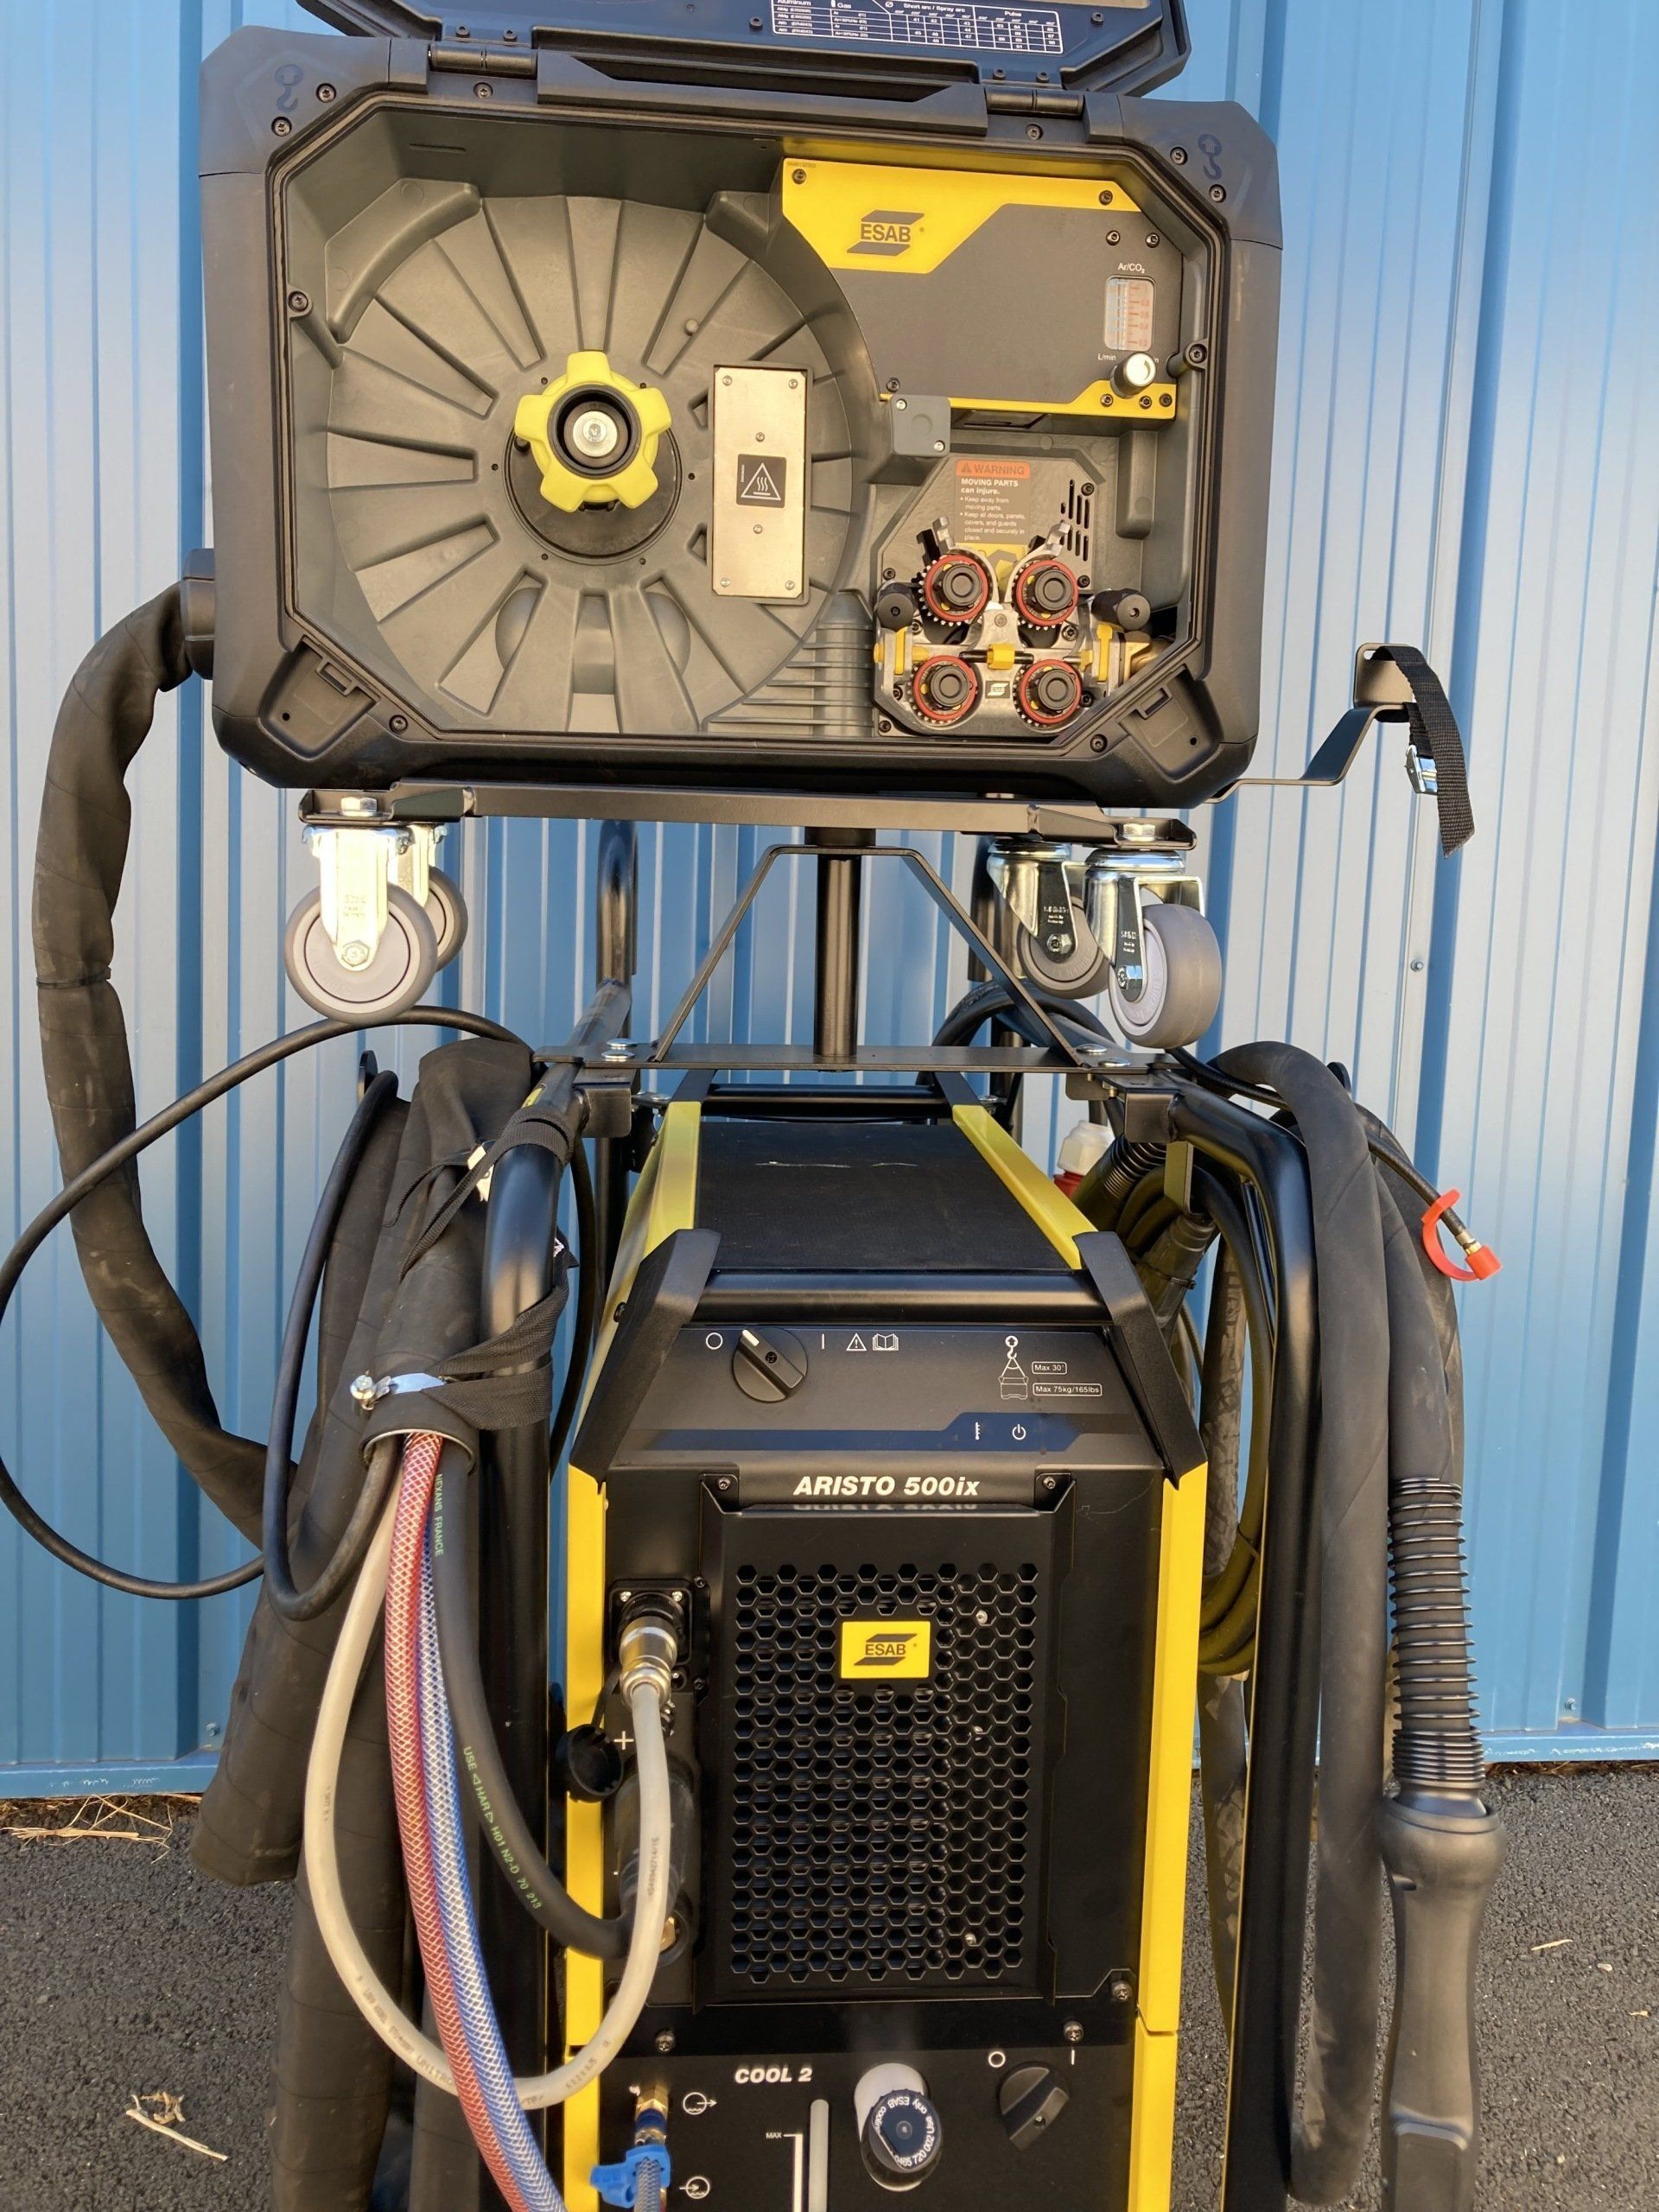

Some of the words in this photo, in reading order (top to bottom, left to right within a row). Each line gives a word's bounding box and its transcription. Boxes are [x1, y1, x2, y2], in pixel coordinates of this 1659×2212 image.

[861, 223, 912, 243] ESAB
[975, 465, 1025, 475] WARNING
[793, 1476, 895, 1496] ARISTO
[904, 1476, 981, 1496] 500ix
[435, 1516, 443, 1557] FRANCE
[866, 1643, 906, 1656] ESAB
[463, 1746, 477, 1771] USE
[501, 1849, 520, 1874] N2-D
[517, 1878, 529, 1890] 70
[734, 2068, 792, 2084] COOL
[798, 2068, 812, 2082] 2
[887, 2096, 910, 2108] ESAB
[912, 2099, 927, 2114] only
[926, 2116, 935, 2134] Use
[912, 2150, 927, 2164] 720
[924, 2135, 934, 2152] 002
